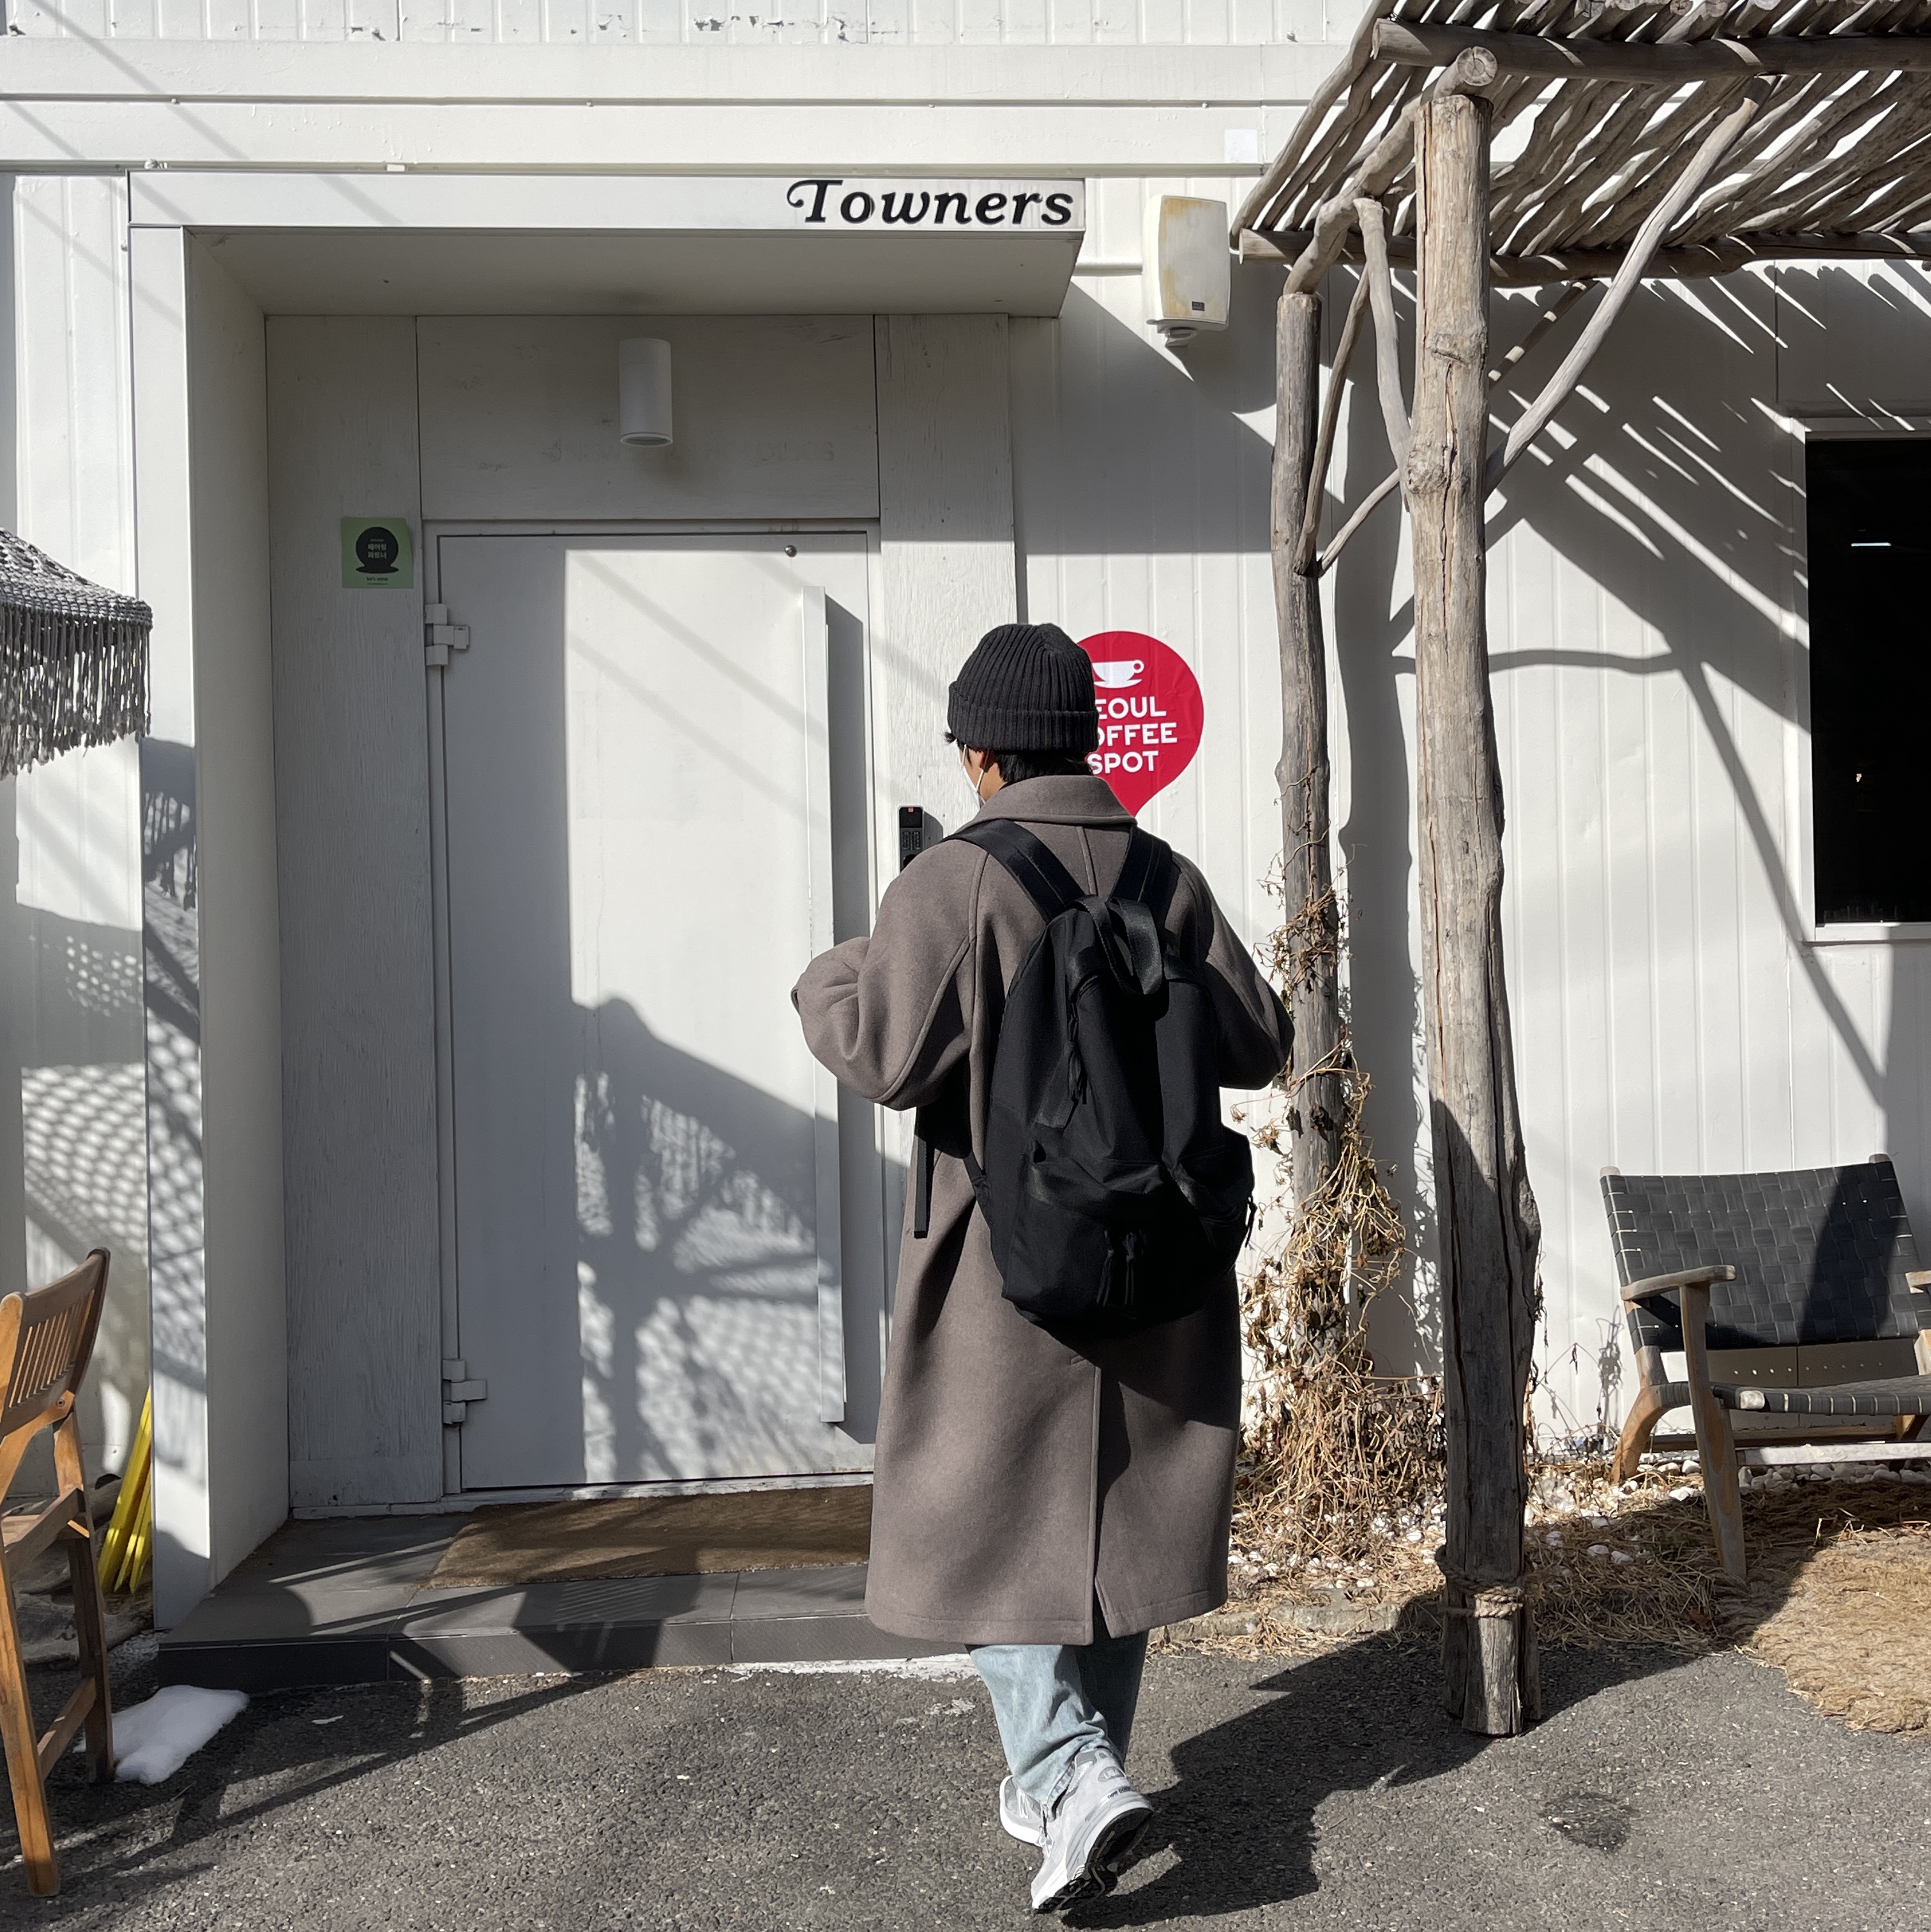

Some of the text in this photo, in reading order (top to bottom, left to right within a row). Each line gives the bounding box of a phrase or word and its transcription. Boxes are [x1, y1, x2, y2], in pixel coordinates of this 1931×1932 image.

[787, 179, 1073, 225] Towners
[1094, 696, 1167, 720] EOUL
[1098, 722, 1178, 746] FFEE
[1087, 750, 1159, 775] SPOT
